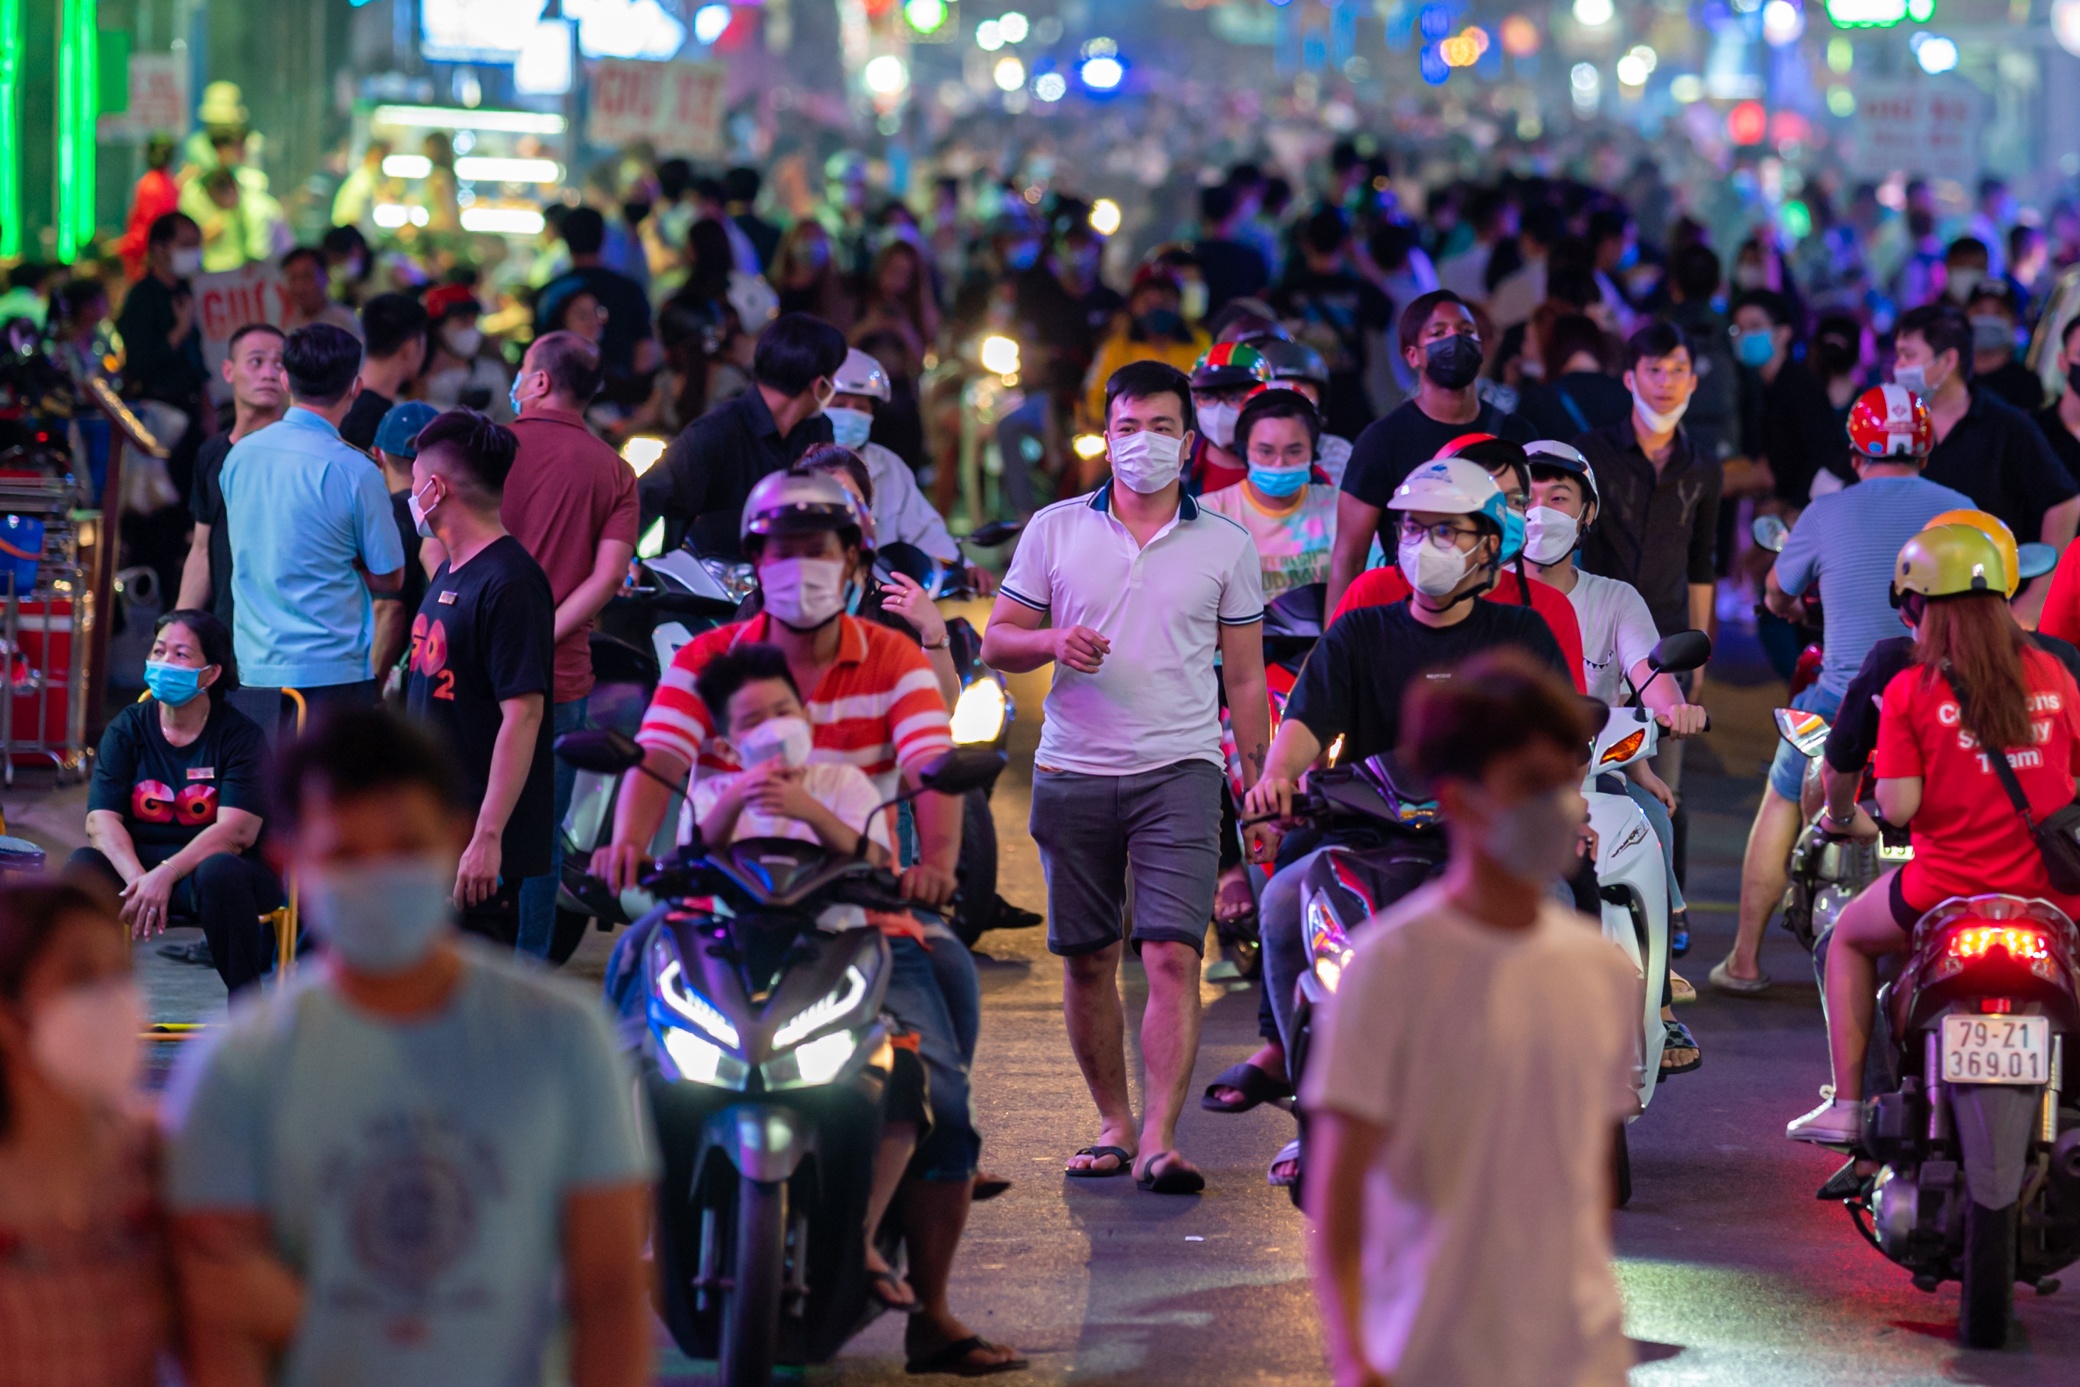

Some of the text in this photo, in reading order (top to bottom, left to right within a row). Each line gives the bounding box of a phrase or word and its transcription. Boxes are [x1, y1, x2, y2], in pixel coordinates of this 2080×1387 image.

[1976, 750, 2040, 773] Tam
[1960, 1022, 2029, 1048] 79-Z1
[1951, 1051, 2038, 1079] 369.01
